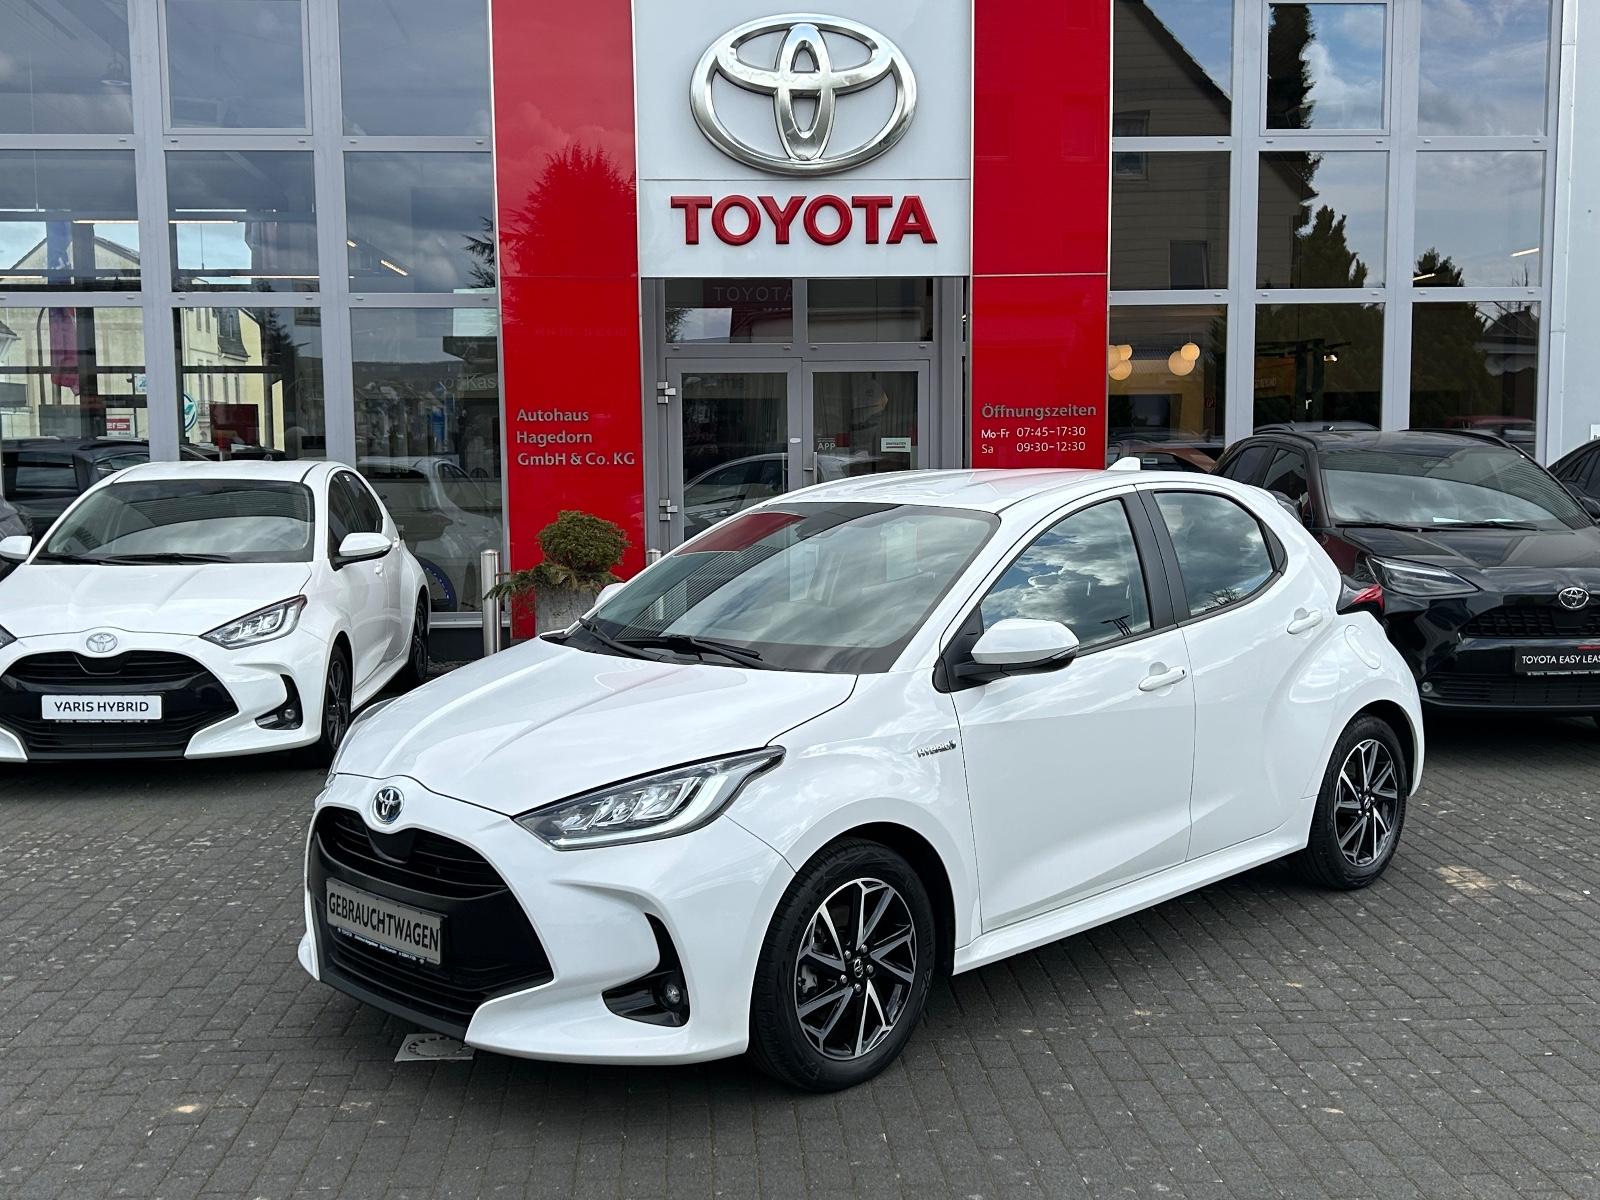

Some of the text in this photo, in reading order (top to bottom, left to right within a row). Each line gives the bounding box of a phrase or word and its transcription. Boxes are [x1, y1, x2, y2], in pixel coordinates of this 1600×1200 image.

[671, 195, 937, 245] TOYOTA
[516, 408, 589, 421] Autohaus
[981, 403, 1097, 420] Öffnungszeiten
[516, 430, 593, 447] Hagedorn
[981, 426, 1086, 439] Mo-Fr 07:45-17:30
[981, 441, 1086, 454] Sa 09:30-12:30
[517, 452, 635, 466] GmbH & Co. KG
[1522, 655, 1557, 664] TOYOTA
[1559, 655, 1581, 664] EASY
[54, 701, 149, 712] YARIS HYBRID
[328, 892, 440, 952] GEBRAUCHTWAGEN
